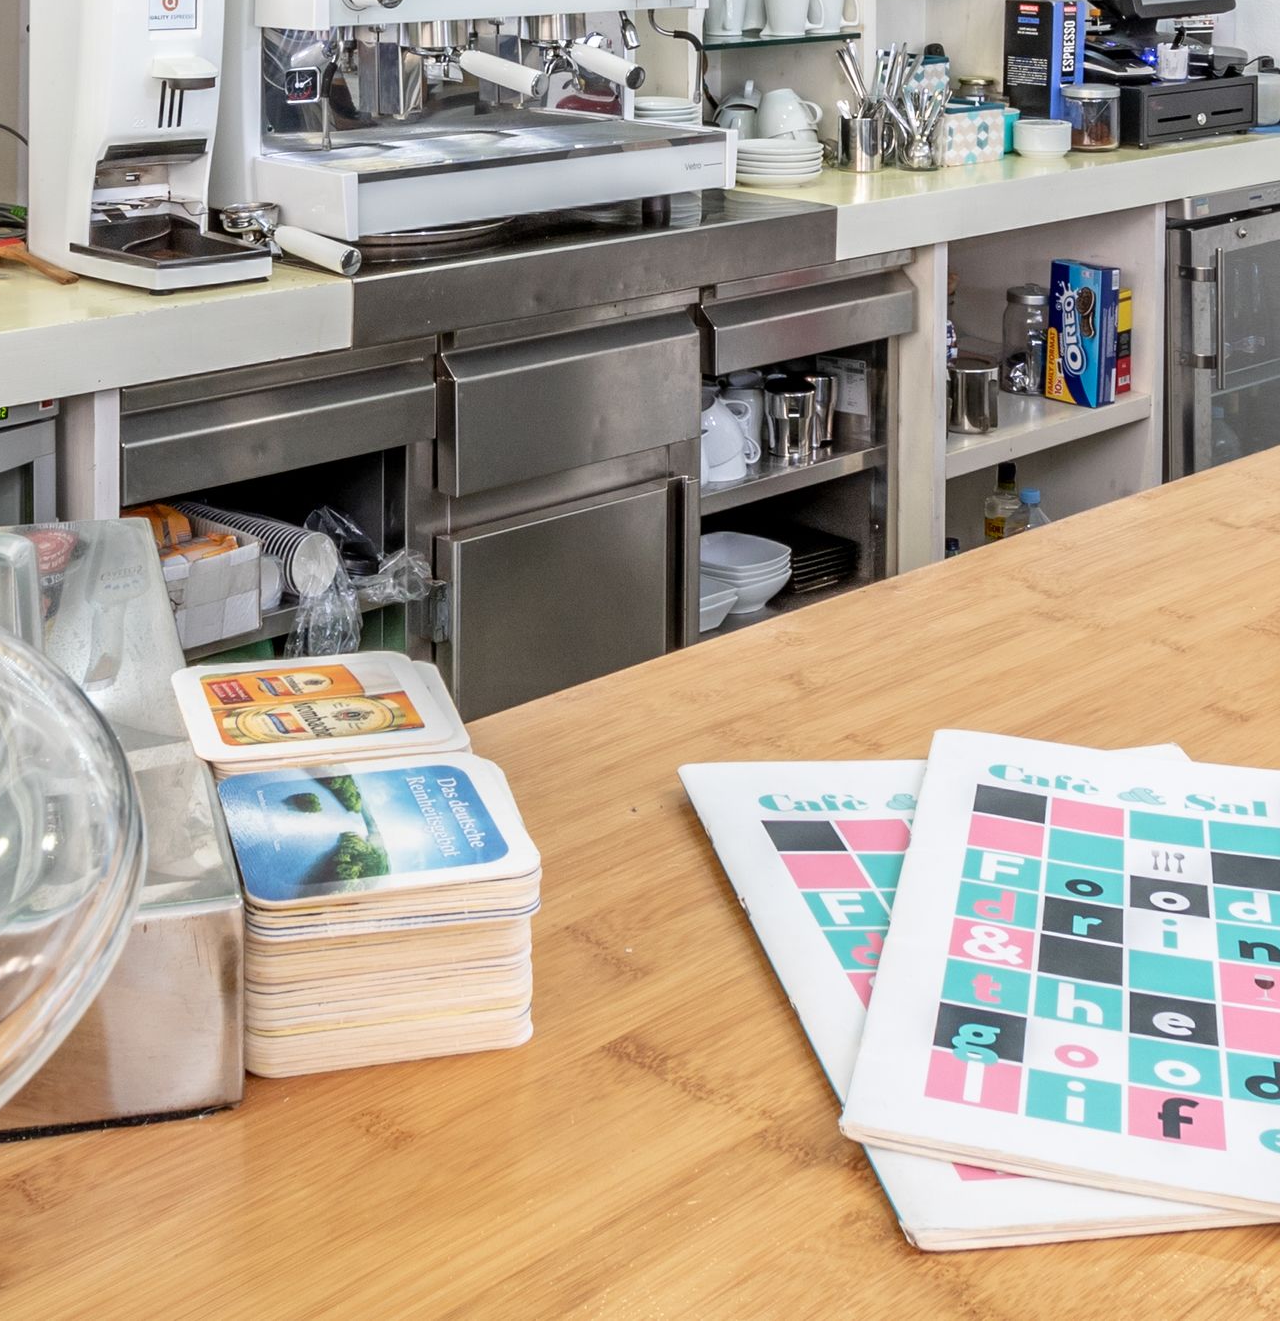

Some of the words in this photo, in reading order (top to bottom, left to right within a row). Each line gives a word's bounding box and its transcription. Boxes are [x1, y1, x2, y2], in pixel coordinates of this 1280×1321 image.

[1061, 20, 1076, 72] ESPRESSO
[1049, 331, 1057, 365] FORMAT
[1064, 295, 1085, 371] OREO
[1048, 365, 1056, 395] FAMILY
[406, 775, 460, 859] Reinheitsgebot
[436, 776, 458, 799] Das
[448, 797, 486, 849] deutsche
[1116, 786, 1167, 807] &
[1183, 792, 1269, 819] Sal
[962, 924, 1024, 966] &
